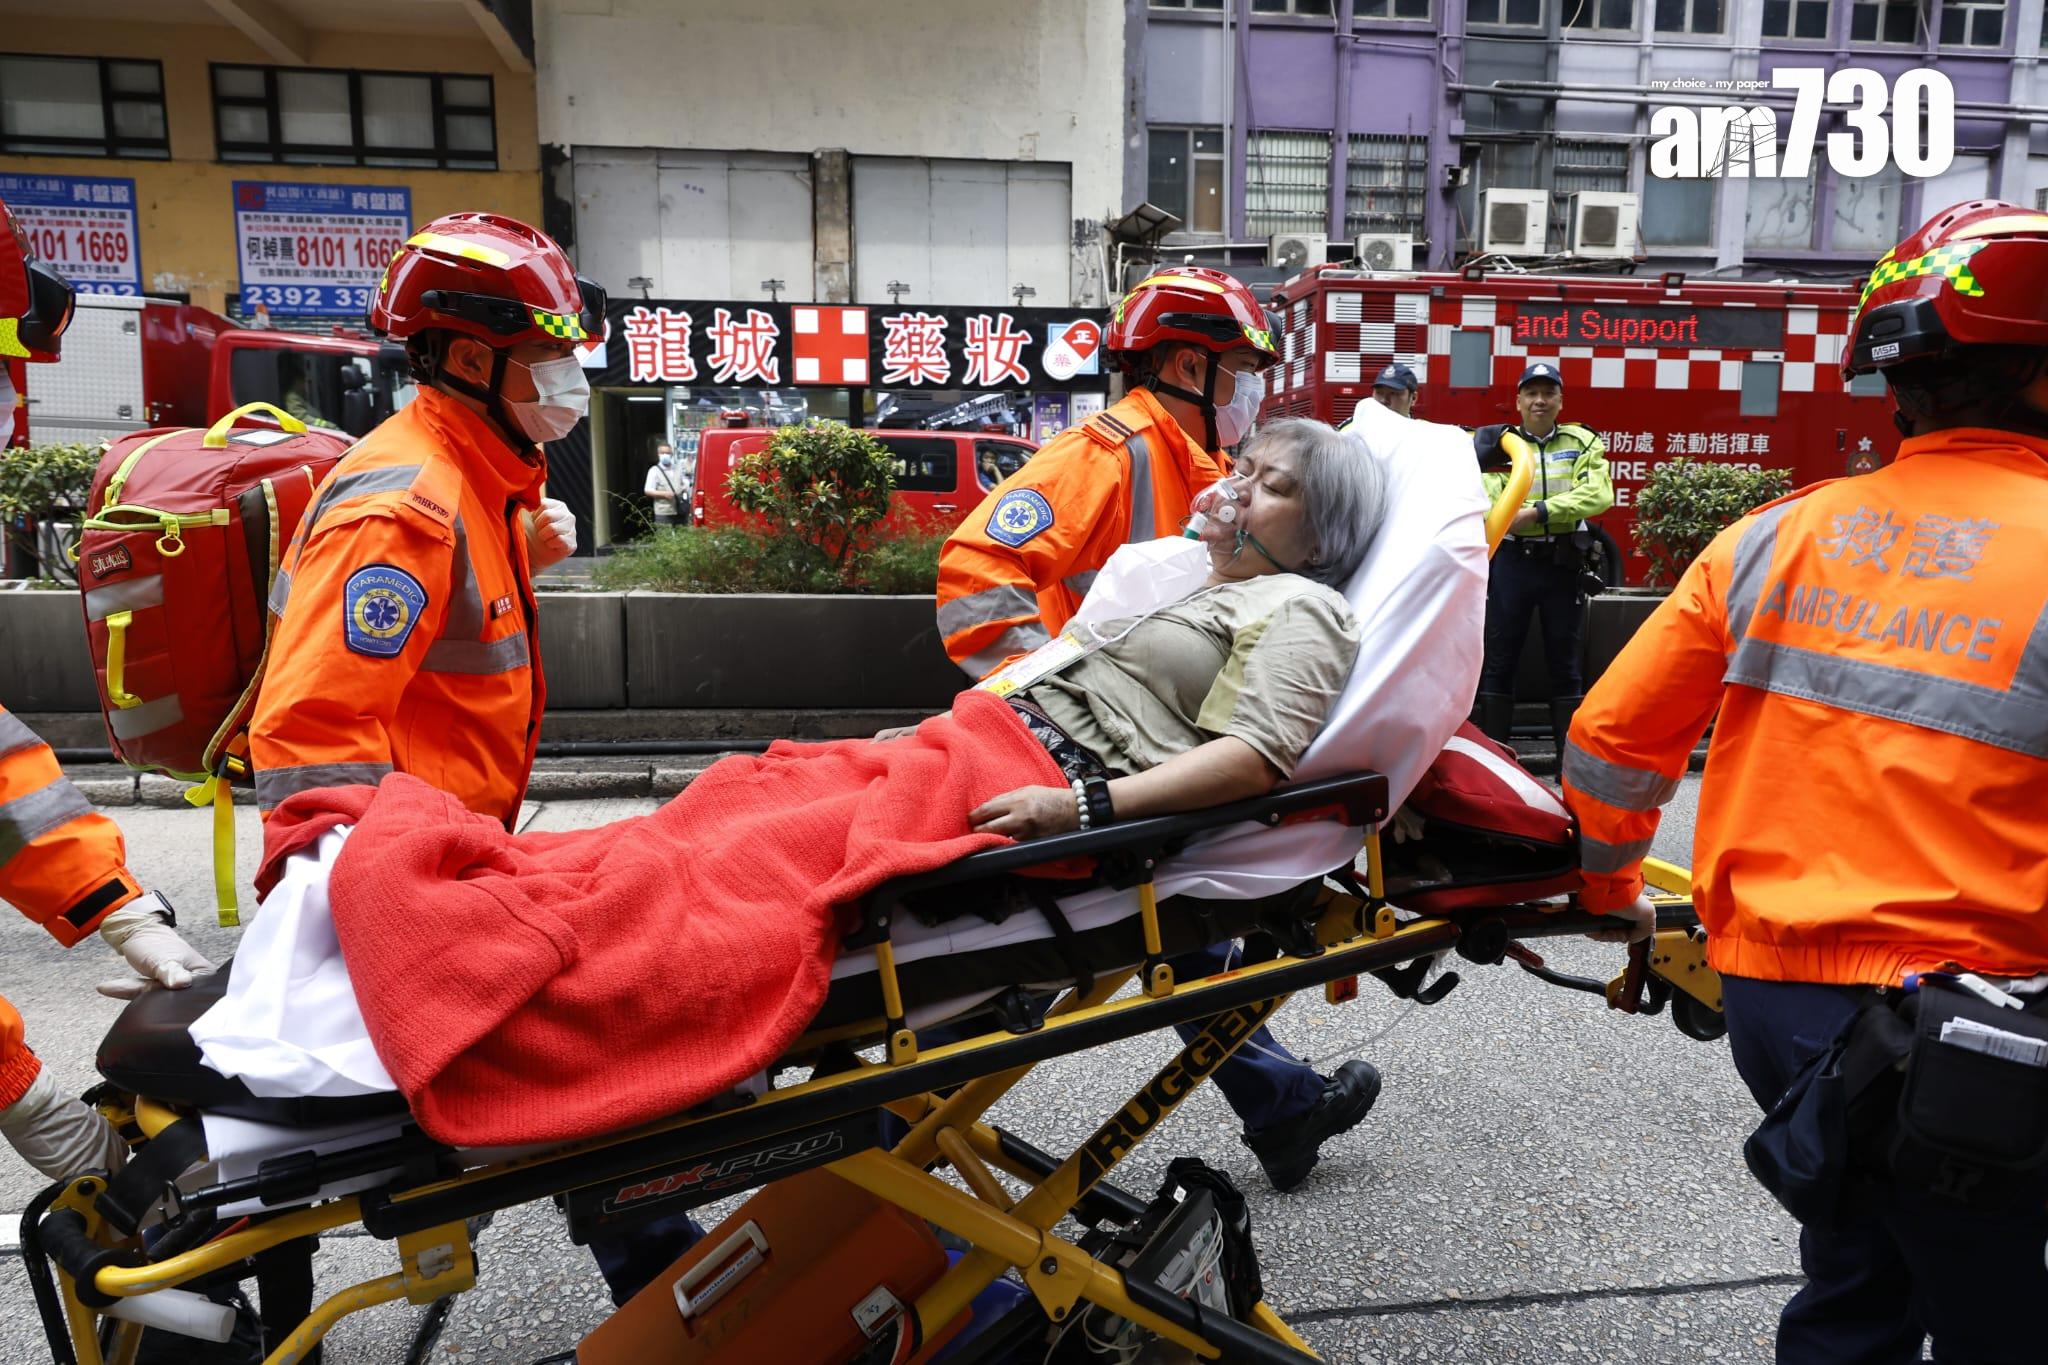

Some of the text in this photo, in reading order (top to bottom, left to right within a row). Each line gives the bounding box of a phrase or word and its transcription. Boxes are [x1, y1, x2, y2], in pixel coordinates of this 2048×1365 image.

[29, 229, 129, 263] 101 1669
[297, 236, 345, 267] 8101
[246, 286, 369, 307] 2392 33
[1072, 330, 1094, 344] 正
[1516, 309, 1698, 344] and Support
[624, 306, 1032, 387] 龍城 藥妝
[1873, 344, 1898, 357] MSA
[1666, 432, 1770, 455] 流動指揮車
[1611, 461, 1647, 480] IRE
[1817, 504, 2001, 582] 救護
[352, 575, 419, 604] PARAMEDIC
[1760, 580, 2001, 662] AMBULANCE
[614, 1131, 836, 1203] MX-PRO
